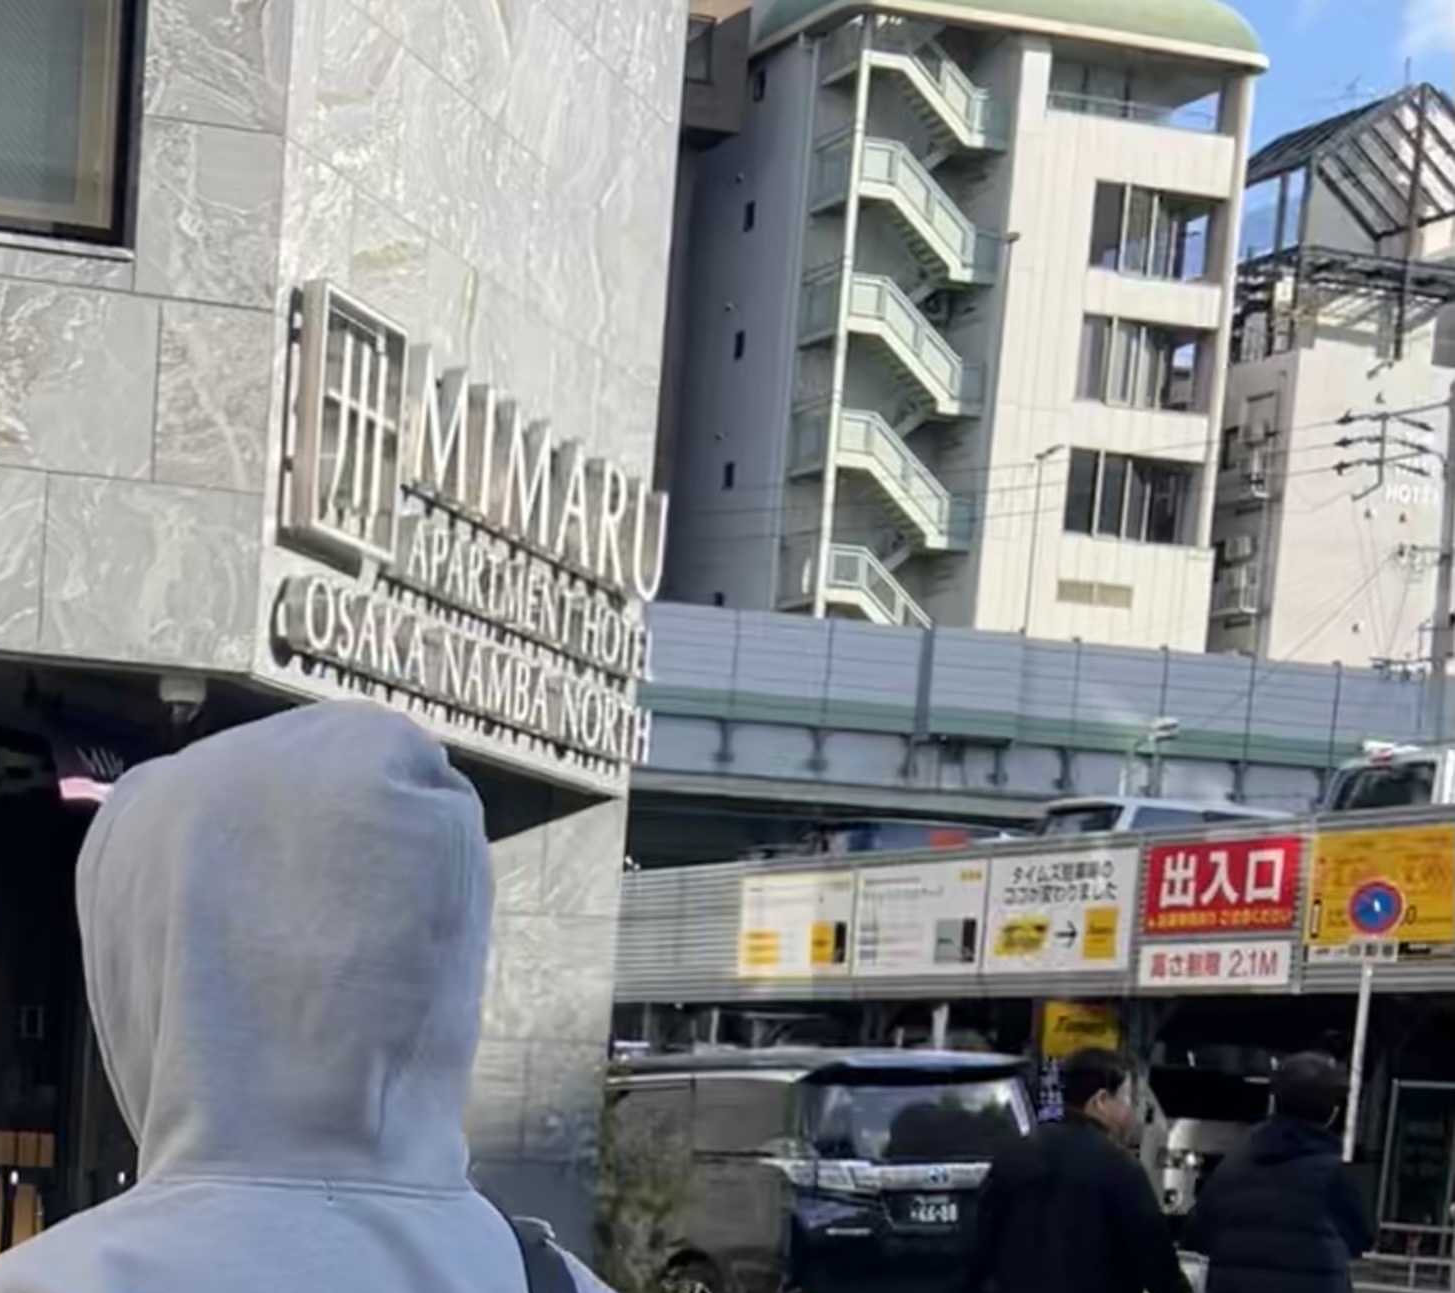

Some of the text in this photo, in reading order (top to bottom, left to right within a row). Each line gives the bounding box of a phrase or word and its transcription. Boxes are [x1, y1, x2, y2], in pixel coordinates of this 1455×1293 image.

[413, 346, 668, 601] MIMARU
[305, 577, 652, 766] OSAKA NAMBA NORTH
[408, 516, 653, 683] APARTMENT HOTEL
[1158, 848, 1286, 909] 出入口
[1226, 949, 1277, 978] 2.1M
